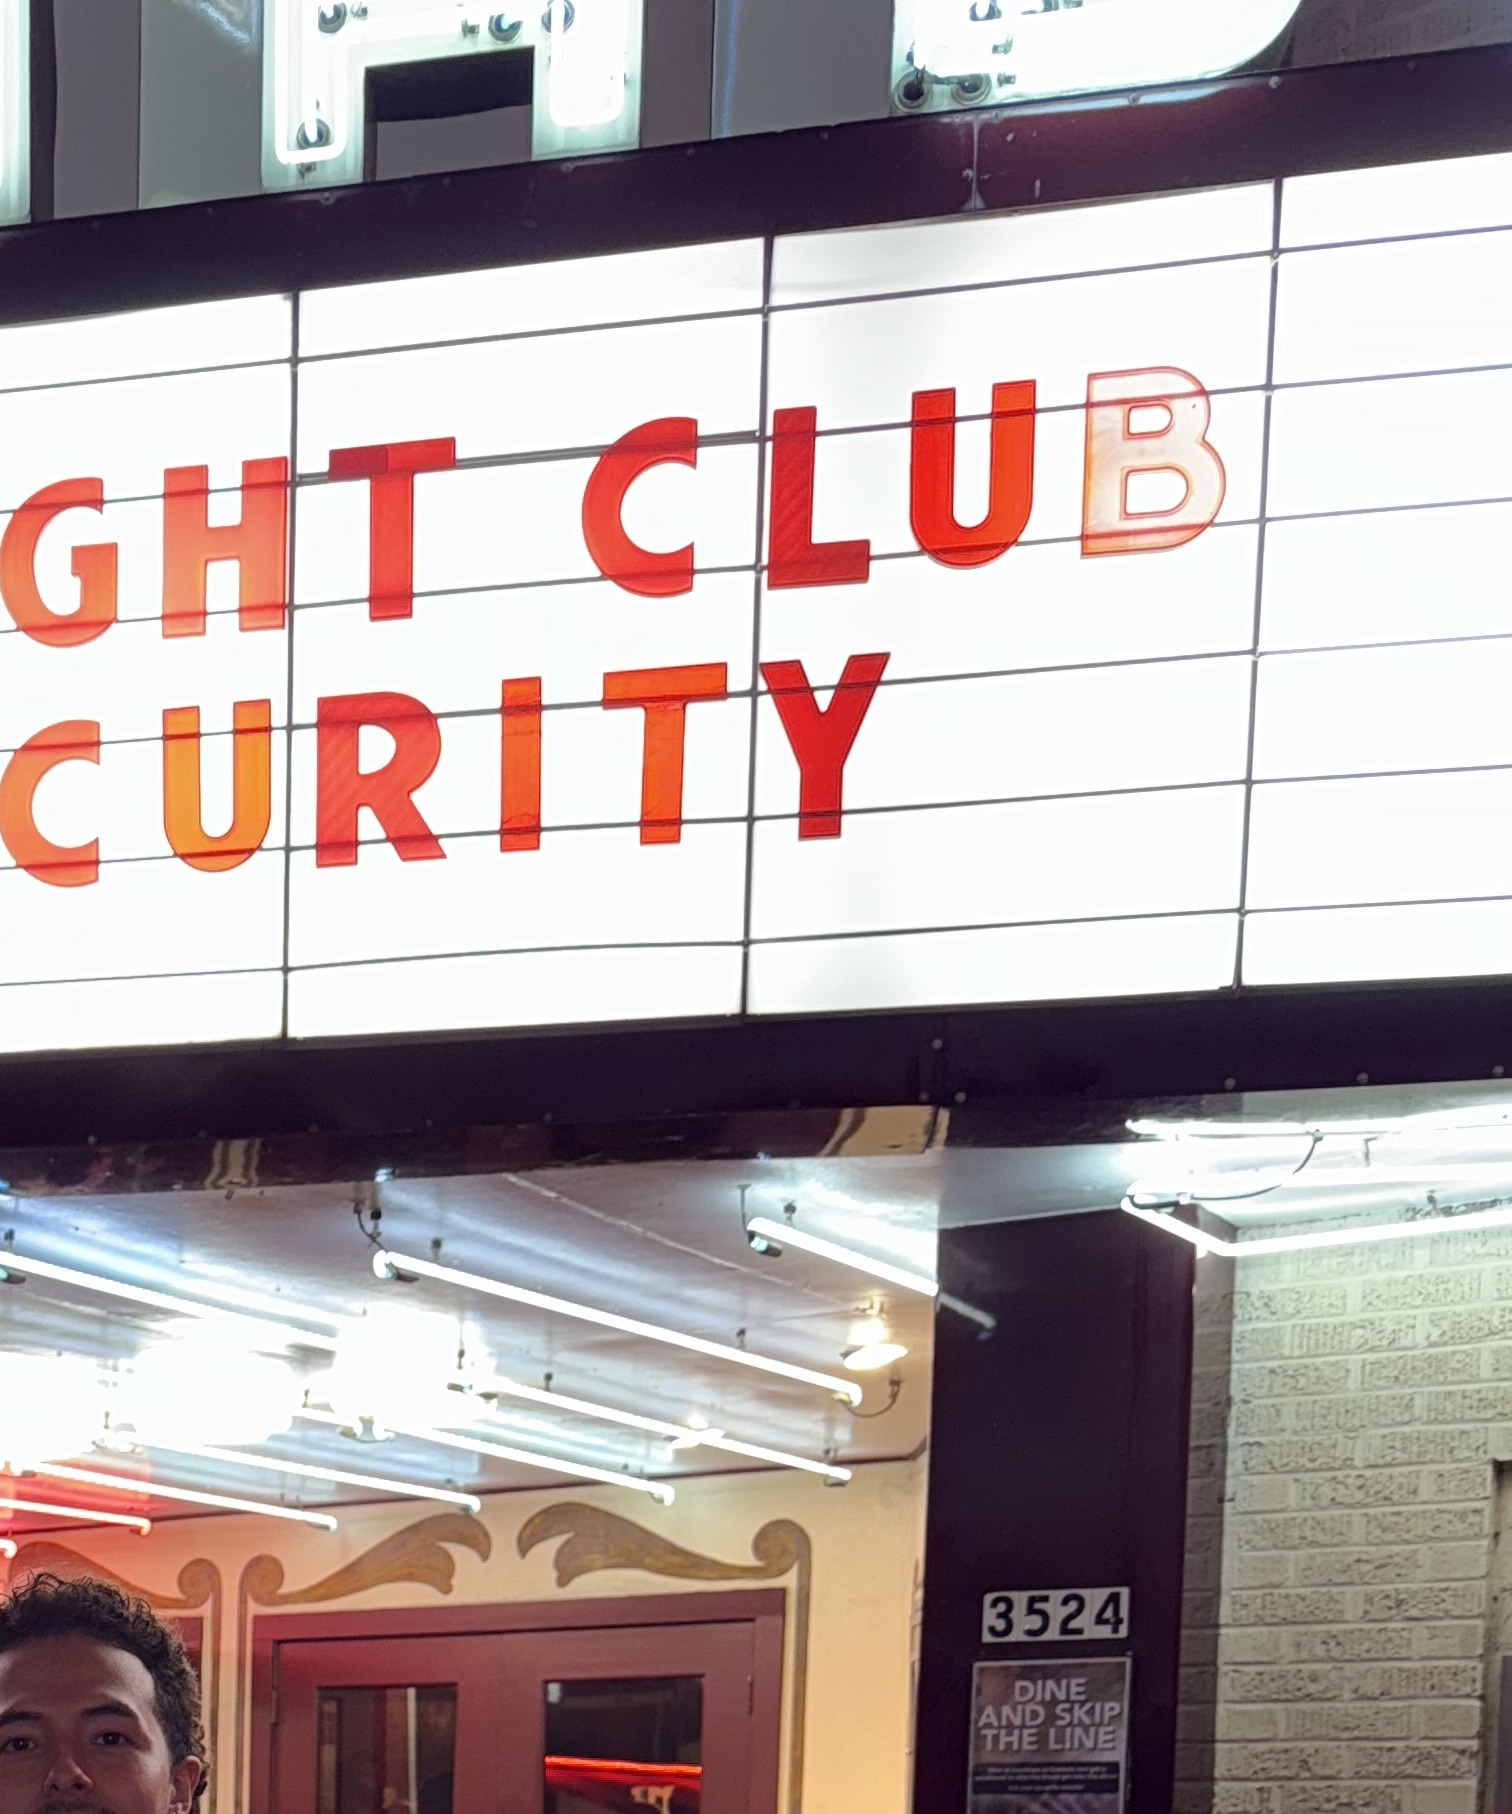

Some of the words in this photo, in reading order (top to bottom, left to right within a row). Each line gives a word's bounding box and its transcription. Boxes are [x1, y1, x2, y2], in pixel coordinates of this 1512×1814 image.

[582, 365, 1226, 598] CLUB
[987, 1592, 1124, 1638] 3524
[1014, 1678, 1088, 1702] DINE
[977, 1703, 1045, 1727] AND
[1054, 1702, 1121, 1725] SKIP
[980, 1728, 1039, 1751] THE
[1048, 1726, 1117, 1750] LINE
